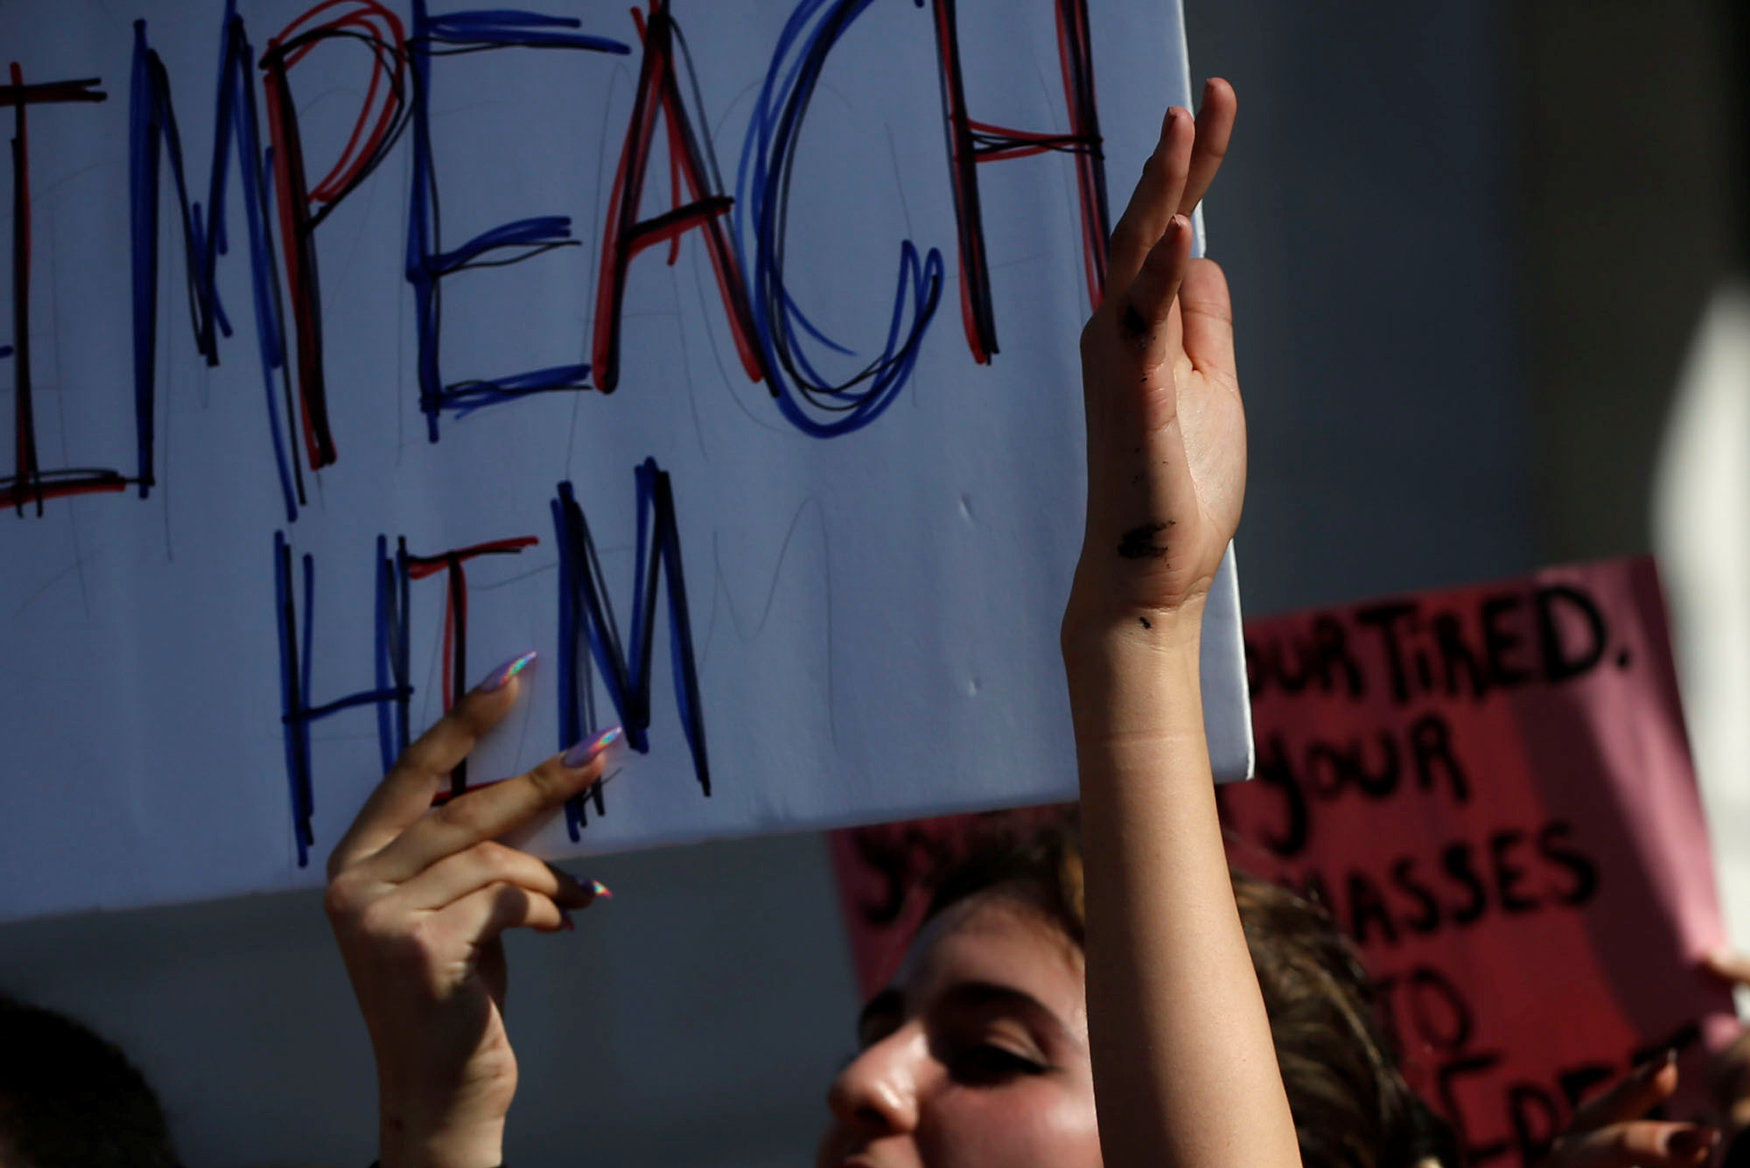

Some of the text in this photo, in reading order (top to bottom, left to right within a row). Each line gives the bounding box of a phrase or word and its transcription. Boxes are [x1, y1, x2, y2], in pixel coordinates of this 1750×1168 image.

[0, 0, 1110, 521] IMPEACH
[275, 456, 712, 867] HIM
[1304, 823, 1596, 942] ASSES
